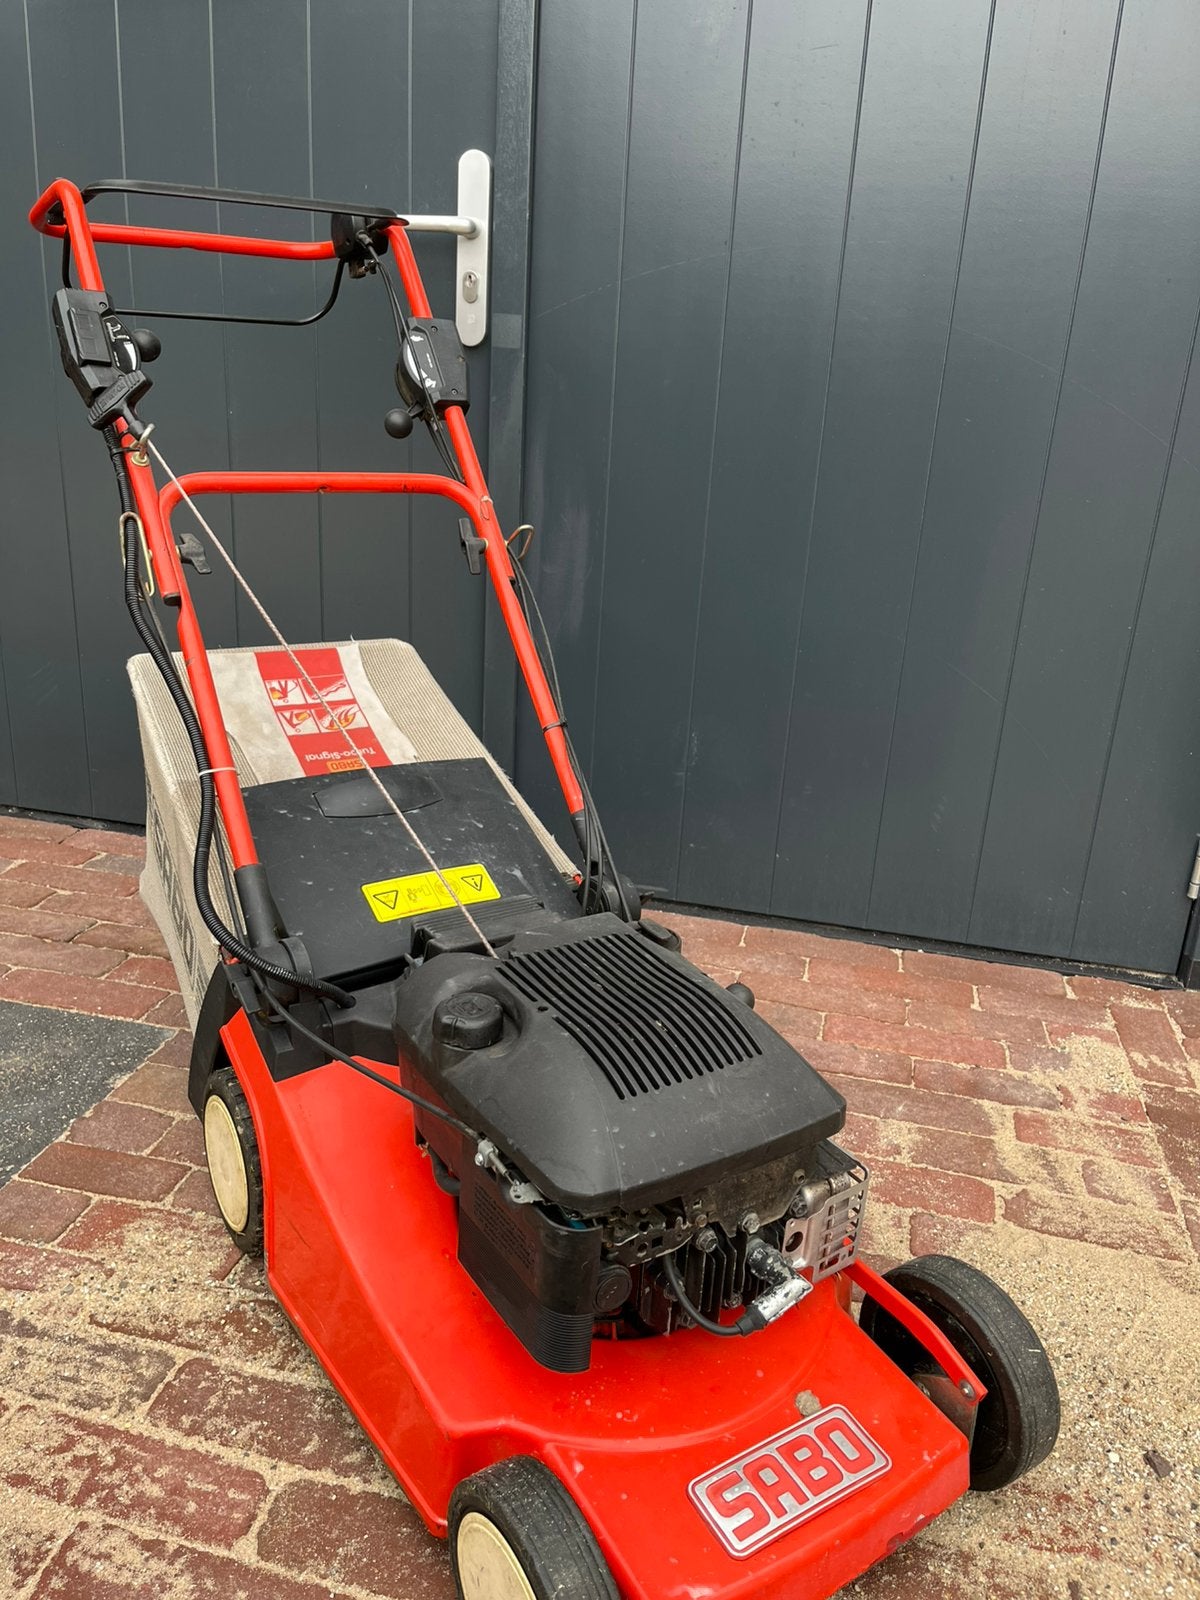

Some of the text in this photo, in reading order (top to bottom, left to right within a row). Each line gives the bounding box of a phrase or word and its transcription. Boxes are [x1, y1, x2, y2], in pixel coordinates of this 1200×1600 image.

[305, 747, 376, 761] Tuo-Signal
[330, 760, 363, 771] SABO
[706, 1417, 875, 1542] SABO
